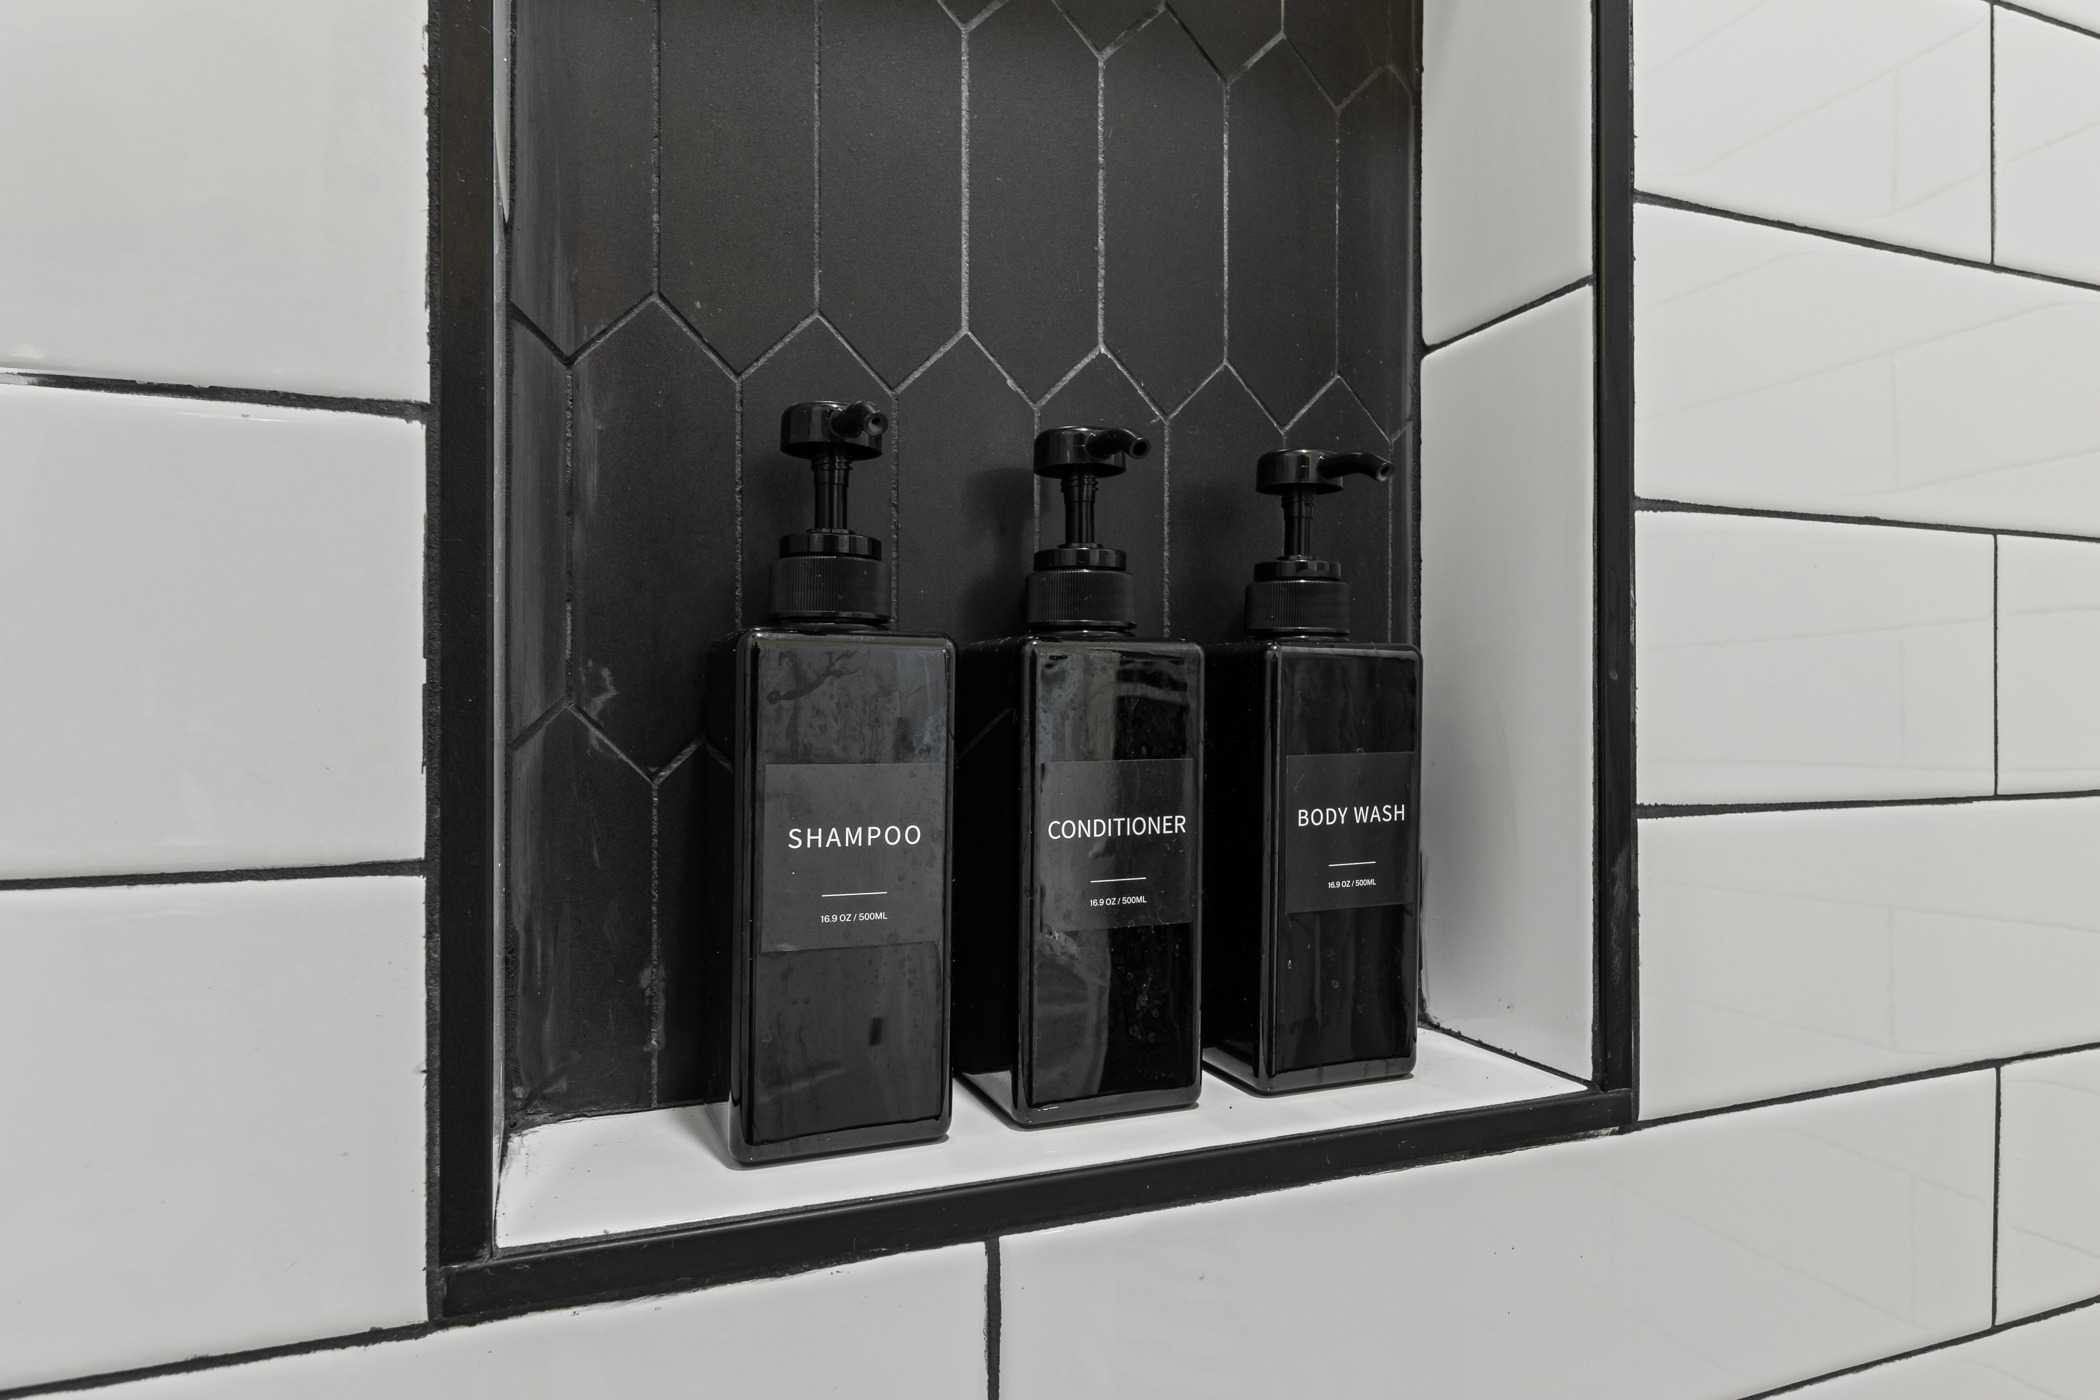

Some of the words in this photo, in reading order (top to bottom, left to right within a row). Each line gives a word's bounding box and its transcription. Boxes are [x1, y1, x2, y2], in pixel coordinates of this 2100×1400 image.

[1298, 807, 1348, 826] BODY
[1354, 804, 1405, 823] WASH
[1048, 815, 1186, 839] CONDITIONER
[788, 825, 921, 849] SHAMPOO
[1327, 880, 1341, 889] 16.9
[1341, 880, 1351, 888] OZ
[1355, 878, 1377, 887] 500ML
[1089, 898, 1105, 907] 16.9
[1105, 897, 1117, 906] OZ
[1121, 895, 1147, 905] 500ML
[820, 914, 838, 923] 16.9
[839, 913, 852, 922] OZ
[858, 912, 887, 921] 500ML
